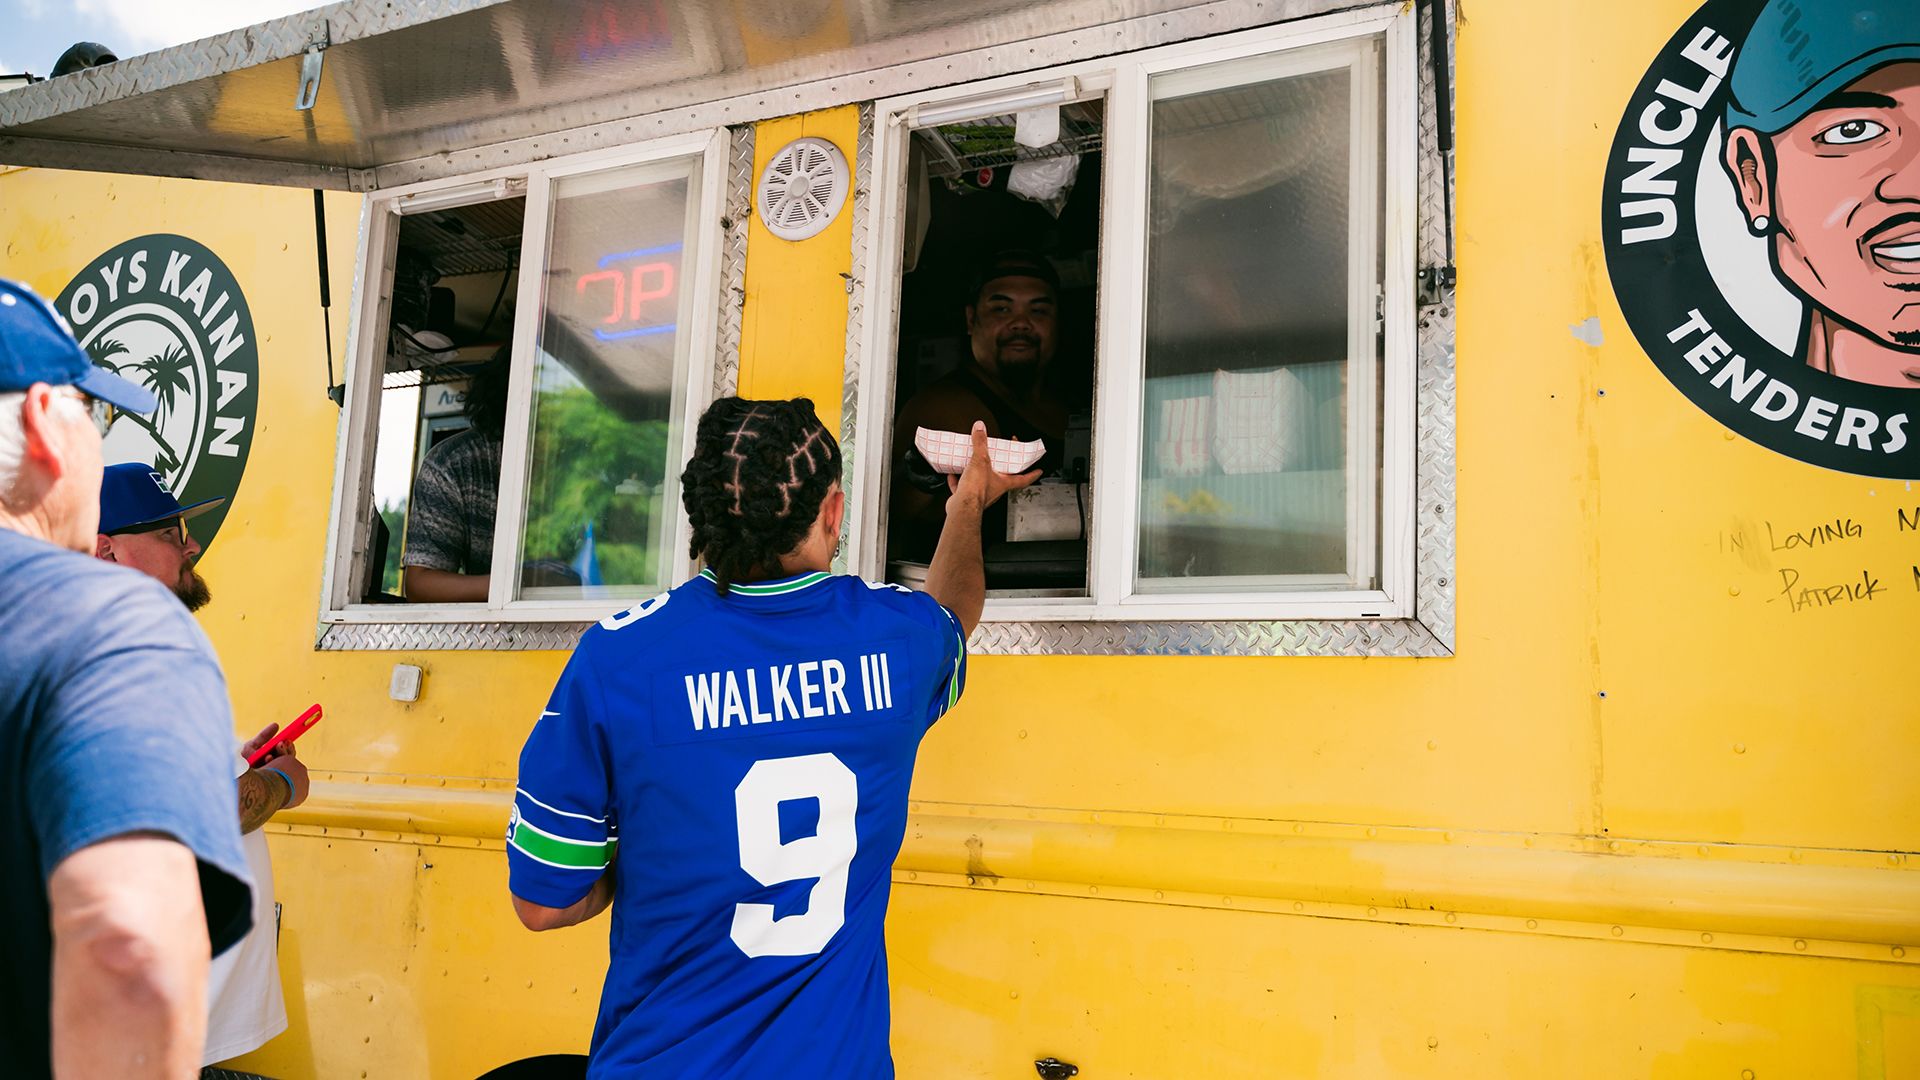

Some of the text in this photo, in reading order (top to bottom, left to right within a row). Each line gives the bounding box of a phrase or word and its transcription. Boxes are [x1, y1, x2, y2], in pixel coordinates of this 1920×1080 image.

[1620, 26, 1735, 244] UNCLE
[159, 250, 248, 458] KAINAN
[1666, 308, 1910, 454] TENDERS
[1764, 518, 1863, 552] LOVING
[684, 652, 893, 731] WALKER III
[730, 752, 858, 959] 9
